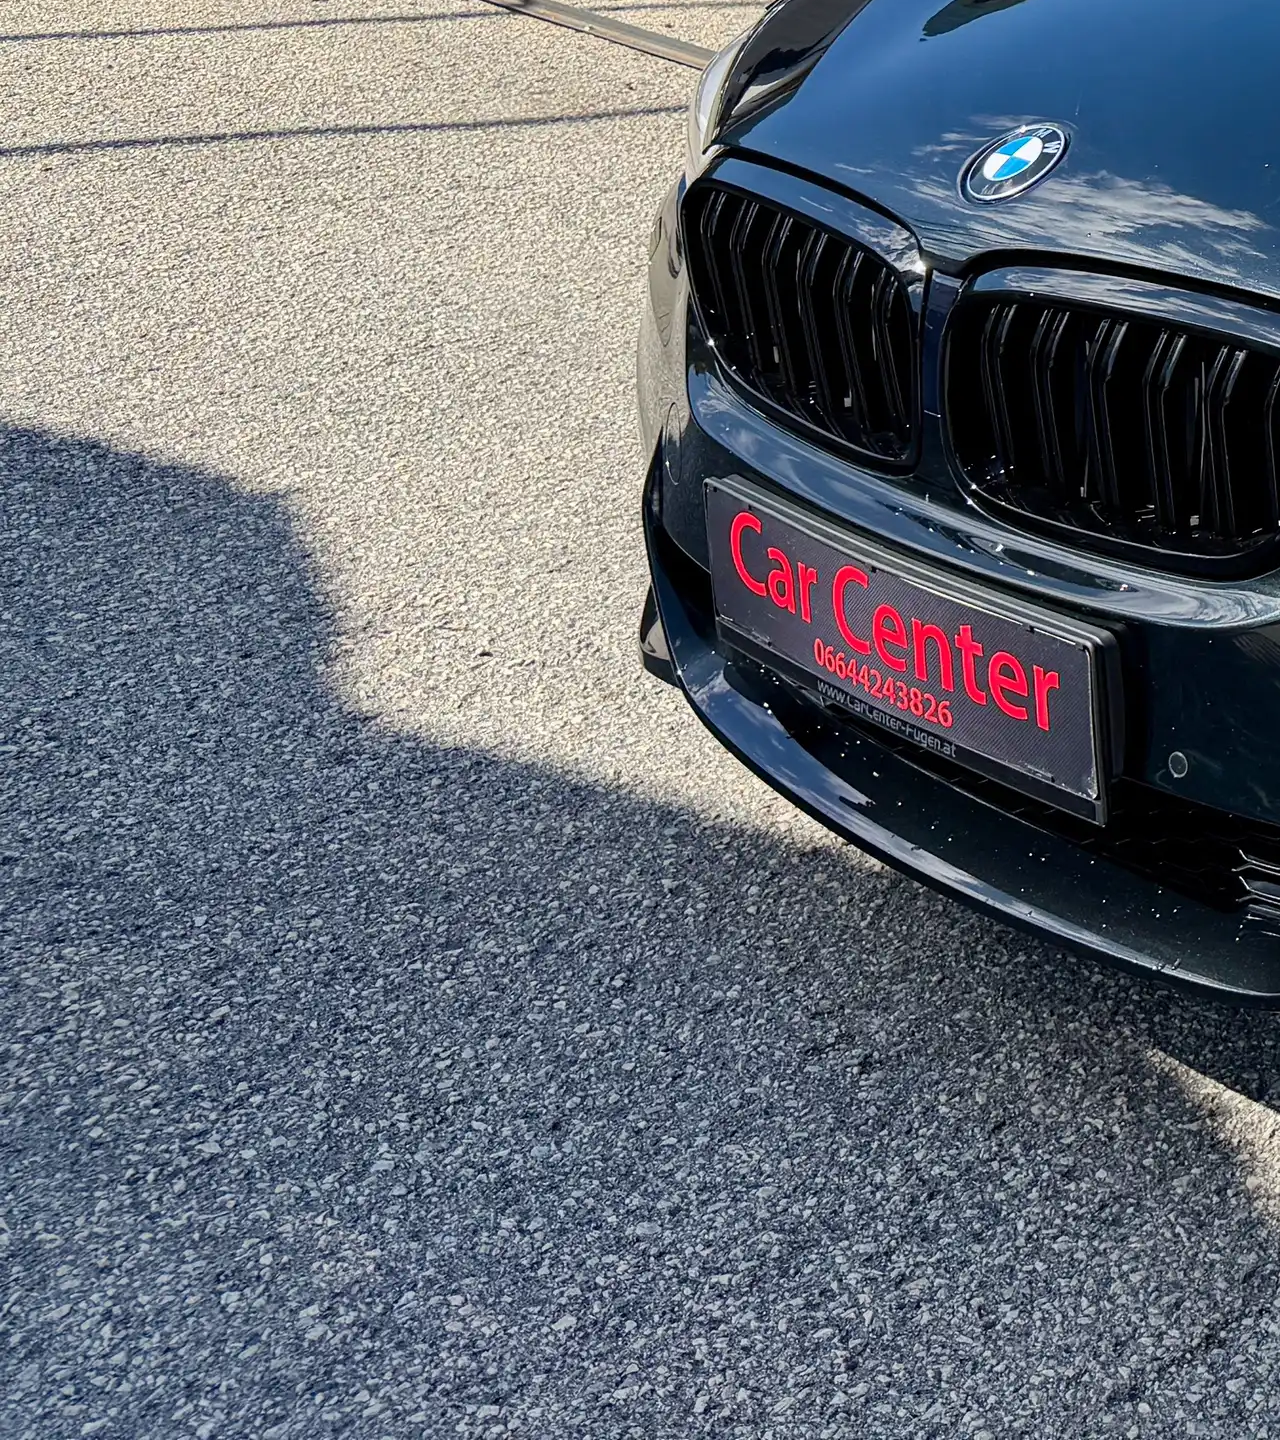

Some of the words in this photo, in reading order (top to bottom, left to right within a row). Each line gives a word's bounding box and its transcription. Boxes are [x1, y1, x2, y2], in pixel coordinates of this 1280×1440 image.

[730, 509, 818, 625] Car
[831, 564, 1061, 732] Center
[813, 637, 954, 729] 06644243826
